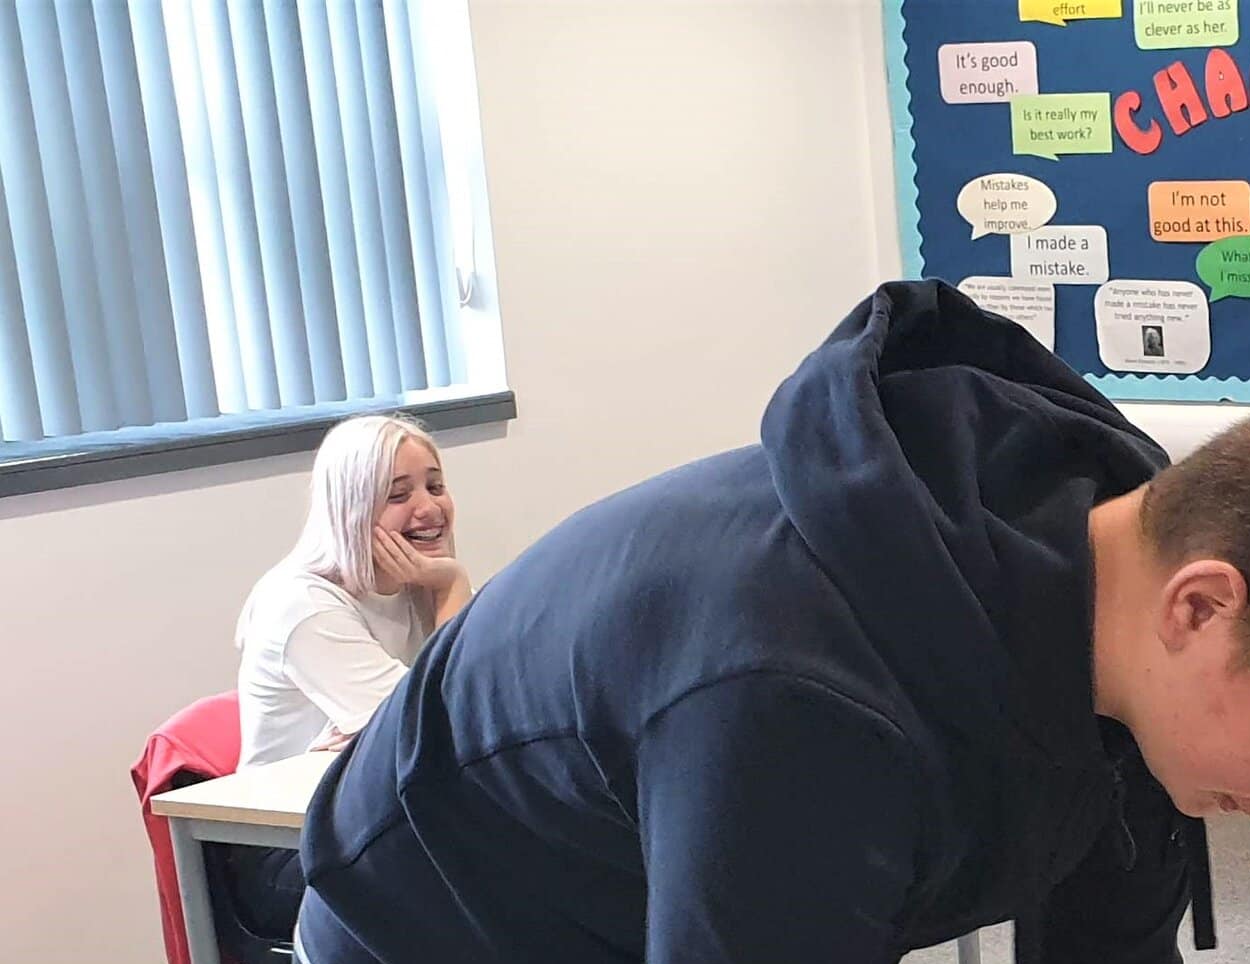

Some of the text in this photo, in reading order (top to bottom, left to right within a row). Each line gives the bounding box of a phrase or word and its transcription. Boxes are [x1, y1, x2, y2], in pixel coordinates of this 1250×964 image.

[1052, 3, 1086, 16] effort
[1139, 0, 1231, 15] I'll never be as
[1145, 21, 1228, 37] clever as her.
[956, 51, 1018, 72] It's good
[959, 78, 1019, 97] enough.
[1023, 108, 1098, 123] Is it really my
[1030, 127, 1092, 141] best work?
[980, 180, 1029, 191] Mistakes
[984, 199, 1028, 211] help me
[1172, 191, 1227, 207] I'm not
[984, 218, 1032, 232] improve.
[1153, 217, 1248, 236] good at this.
[1027, 235, 1089, 250] I made a
[1030, 261, 1089, 276] mistake.
[1221, 271, 1224, 281] I
